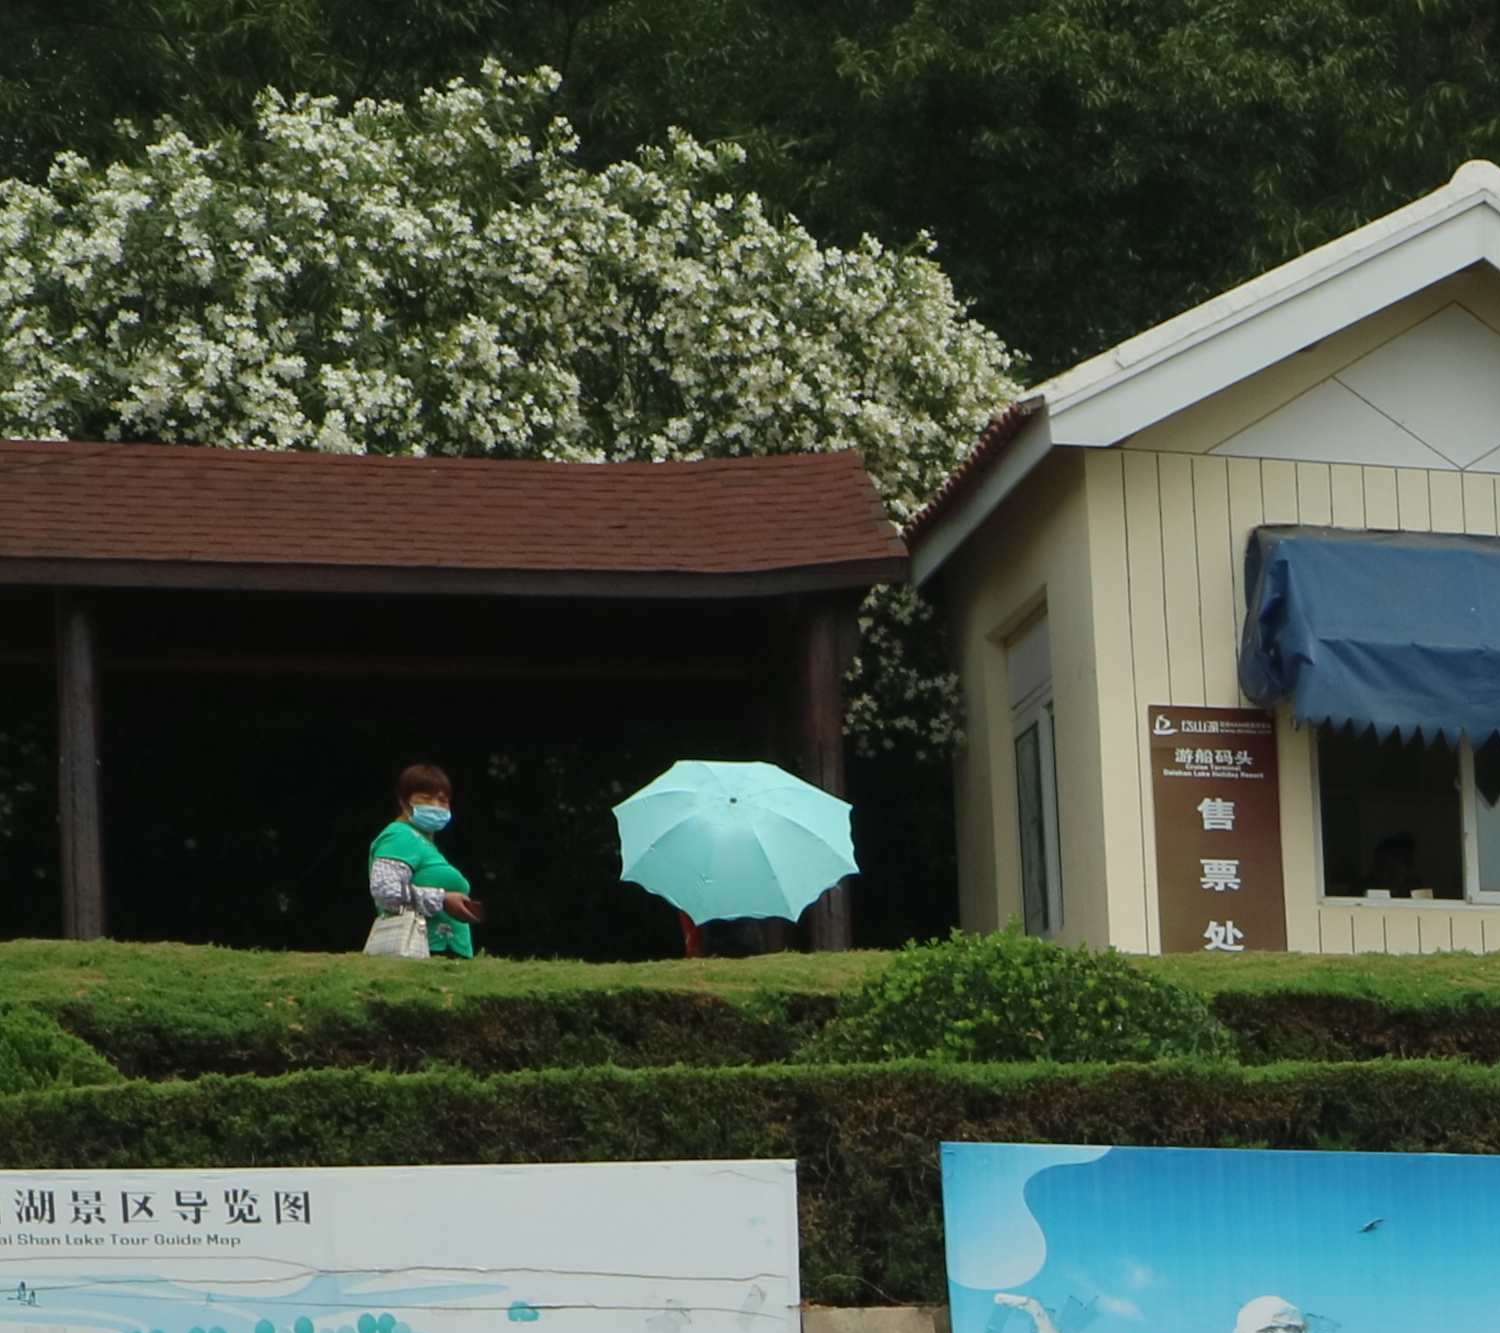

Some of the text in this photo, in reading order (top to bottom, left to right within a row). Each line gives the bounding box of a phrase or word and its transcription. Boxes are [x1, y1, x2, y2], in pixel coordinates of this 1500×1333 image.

[1175, 748, 1253, 765] 游船码头
[1197, 798, 1244, 951] 售票处
[17, 1234, 61, 1246] Shan
[66, 1234, 104, 1246] Lake
[110, 1234, 149, 1246] Tour
[154, 1233, 201, 1246] Guide
[207, 1234, 241, 1248] Map
